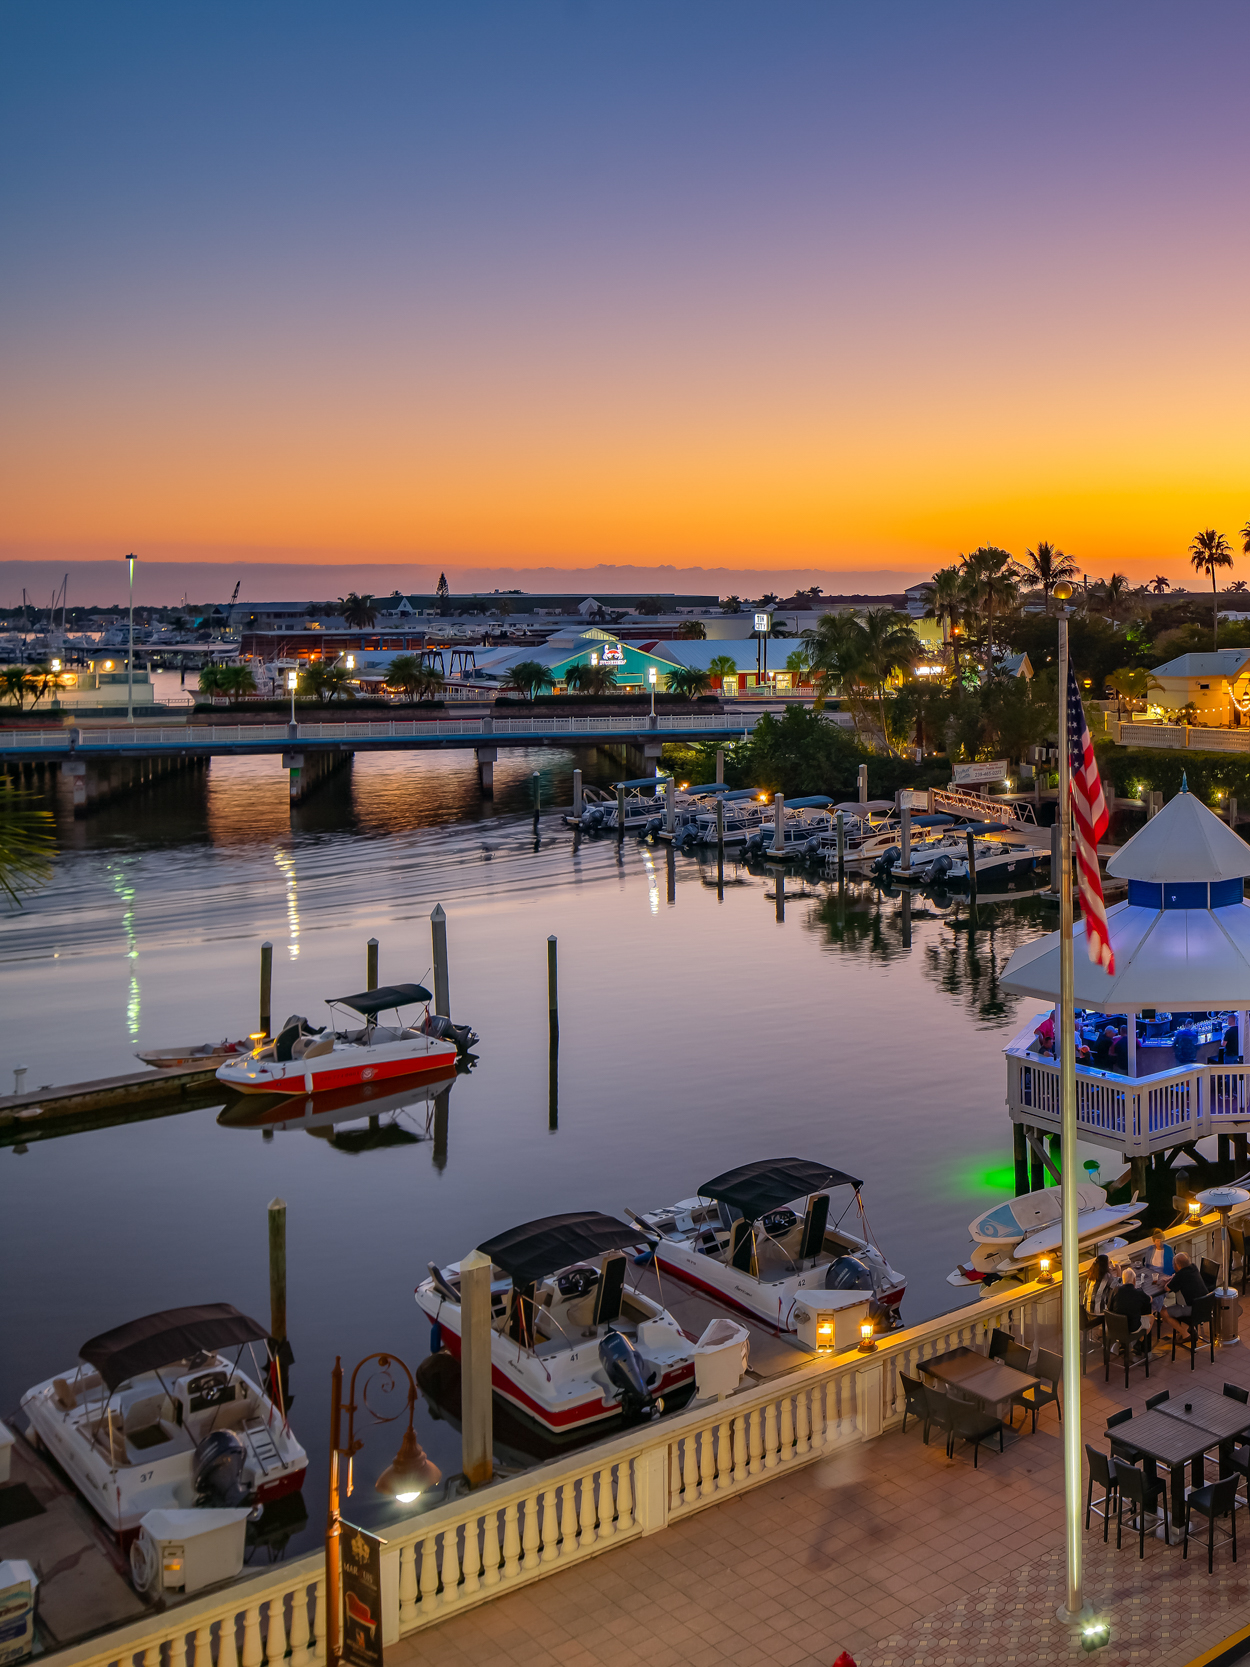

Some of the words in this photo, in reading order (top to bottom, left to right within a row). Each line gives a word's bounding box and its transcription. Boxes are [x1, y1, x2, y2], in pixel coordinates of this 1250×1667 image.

[797, 1279, 806, 1287] 42
[570, 1353, 579, 1362] 41
[140, 1470, 154, 1483] 37
[343, 1562, 373, 1584] MARUIS
